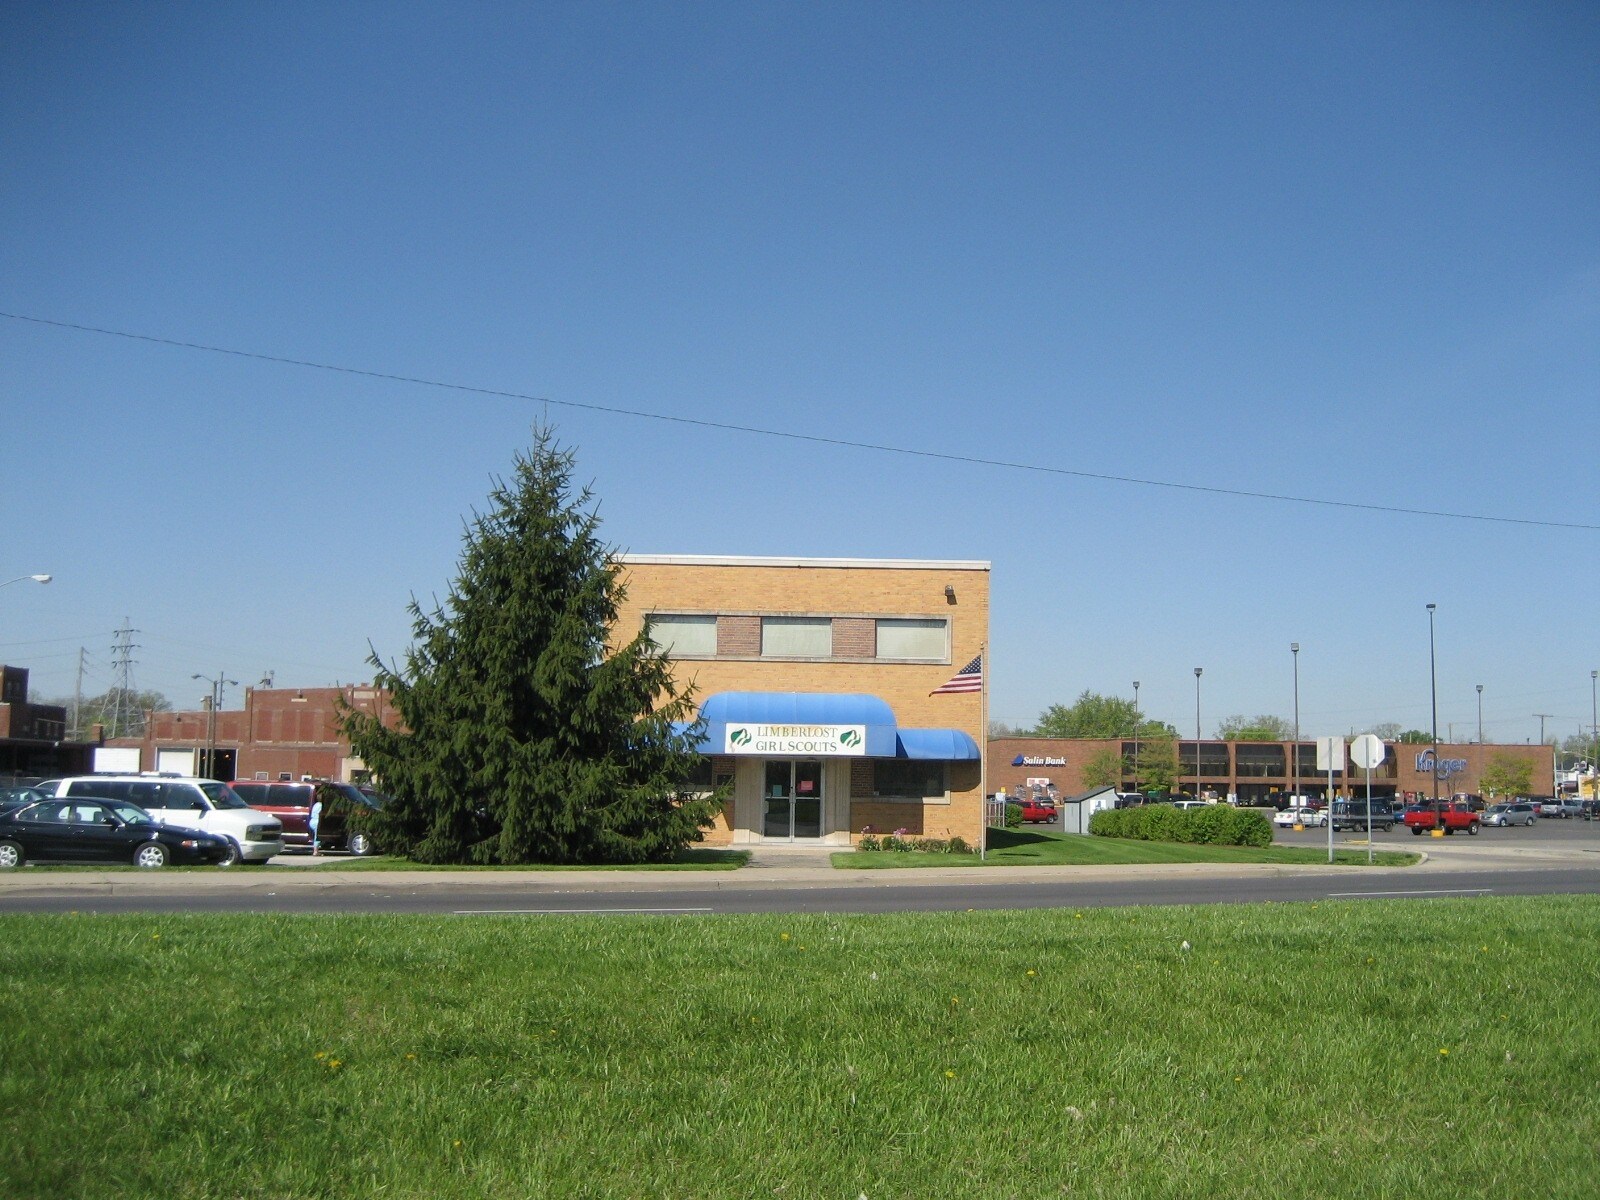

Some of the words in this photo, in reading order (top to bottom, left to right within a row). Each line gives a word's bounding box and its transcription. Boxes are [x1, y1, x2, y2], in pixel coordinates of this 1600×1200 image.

[757, 726, 839, 738] LIMBERLOST
[1023, 755, 1044, 765] Salin
[1045, 755, 1066, 765] Bank
